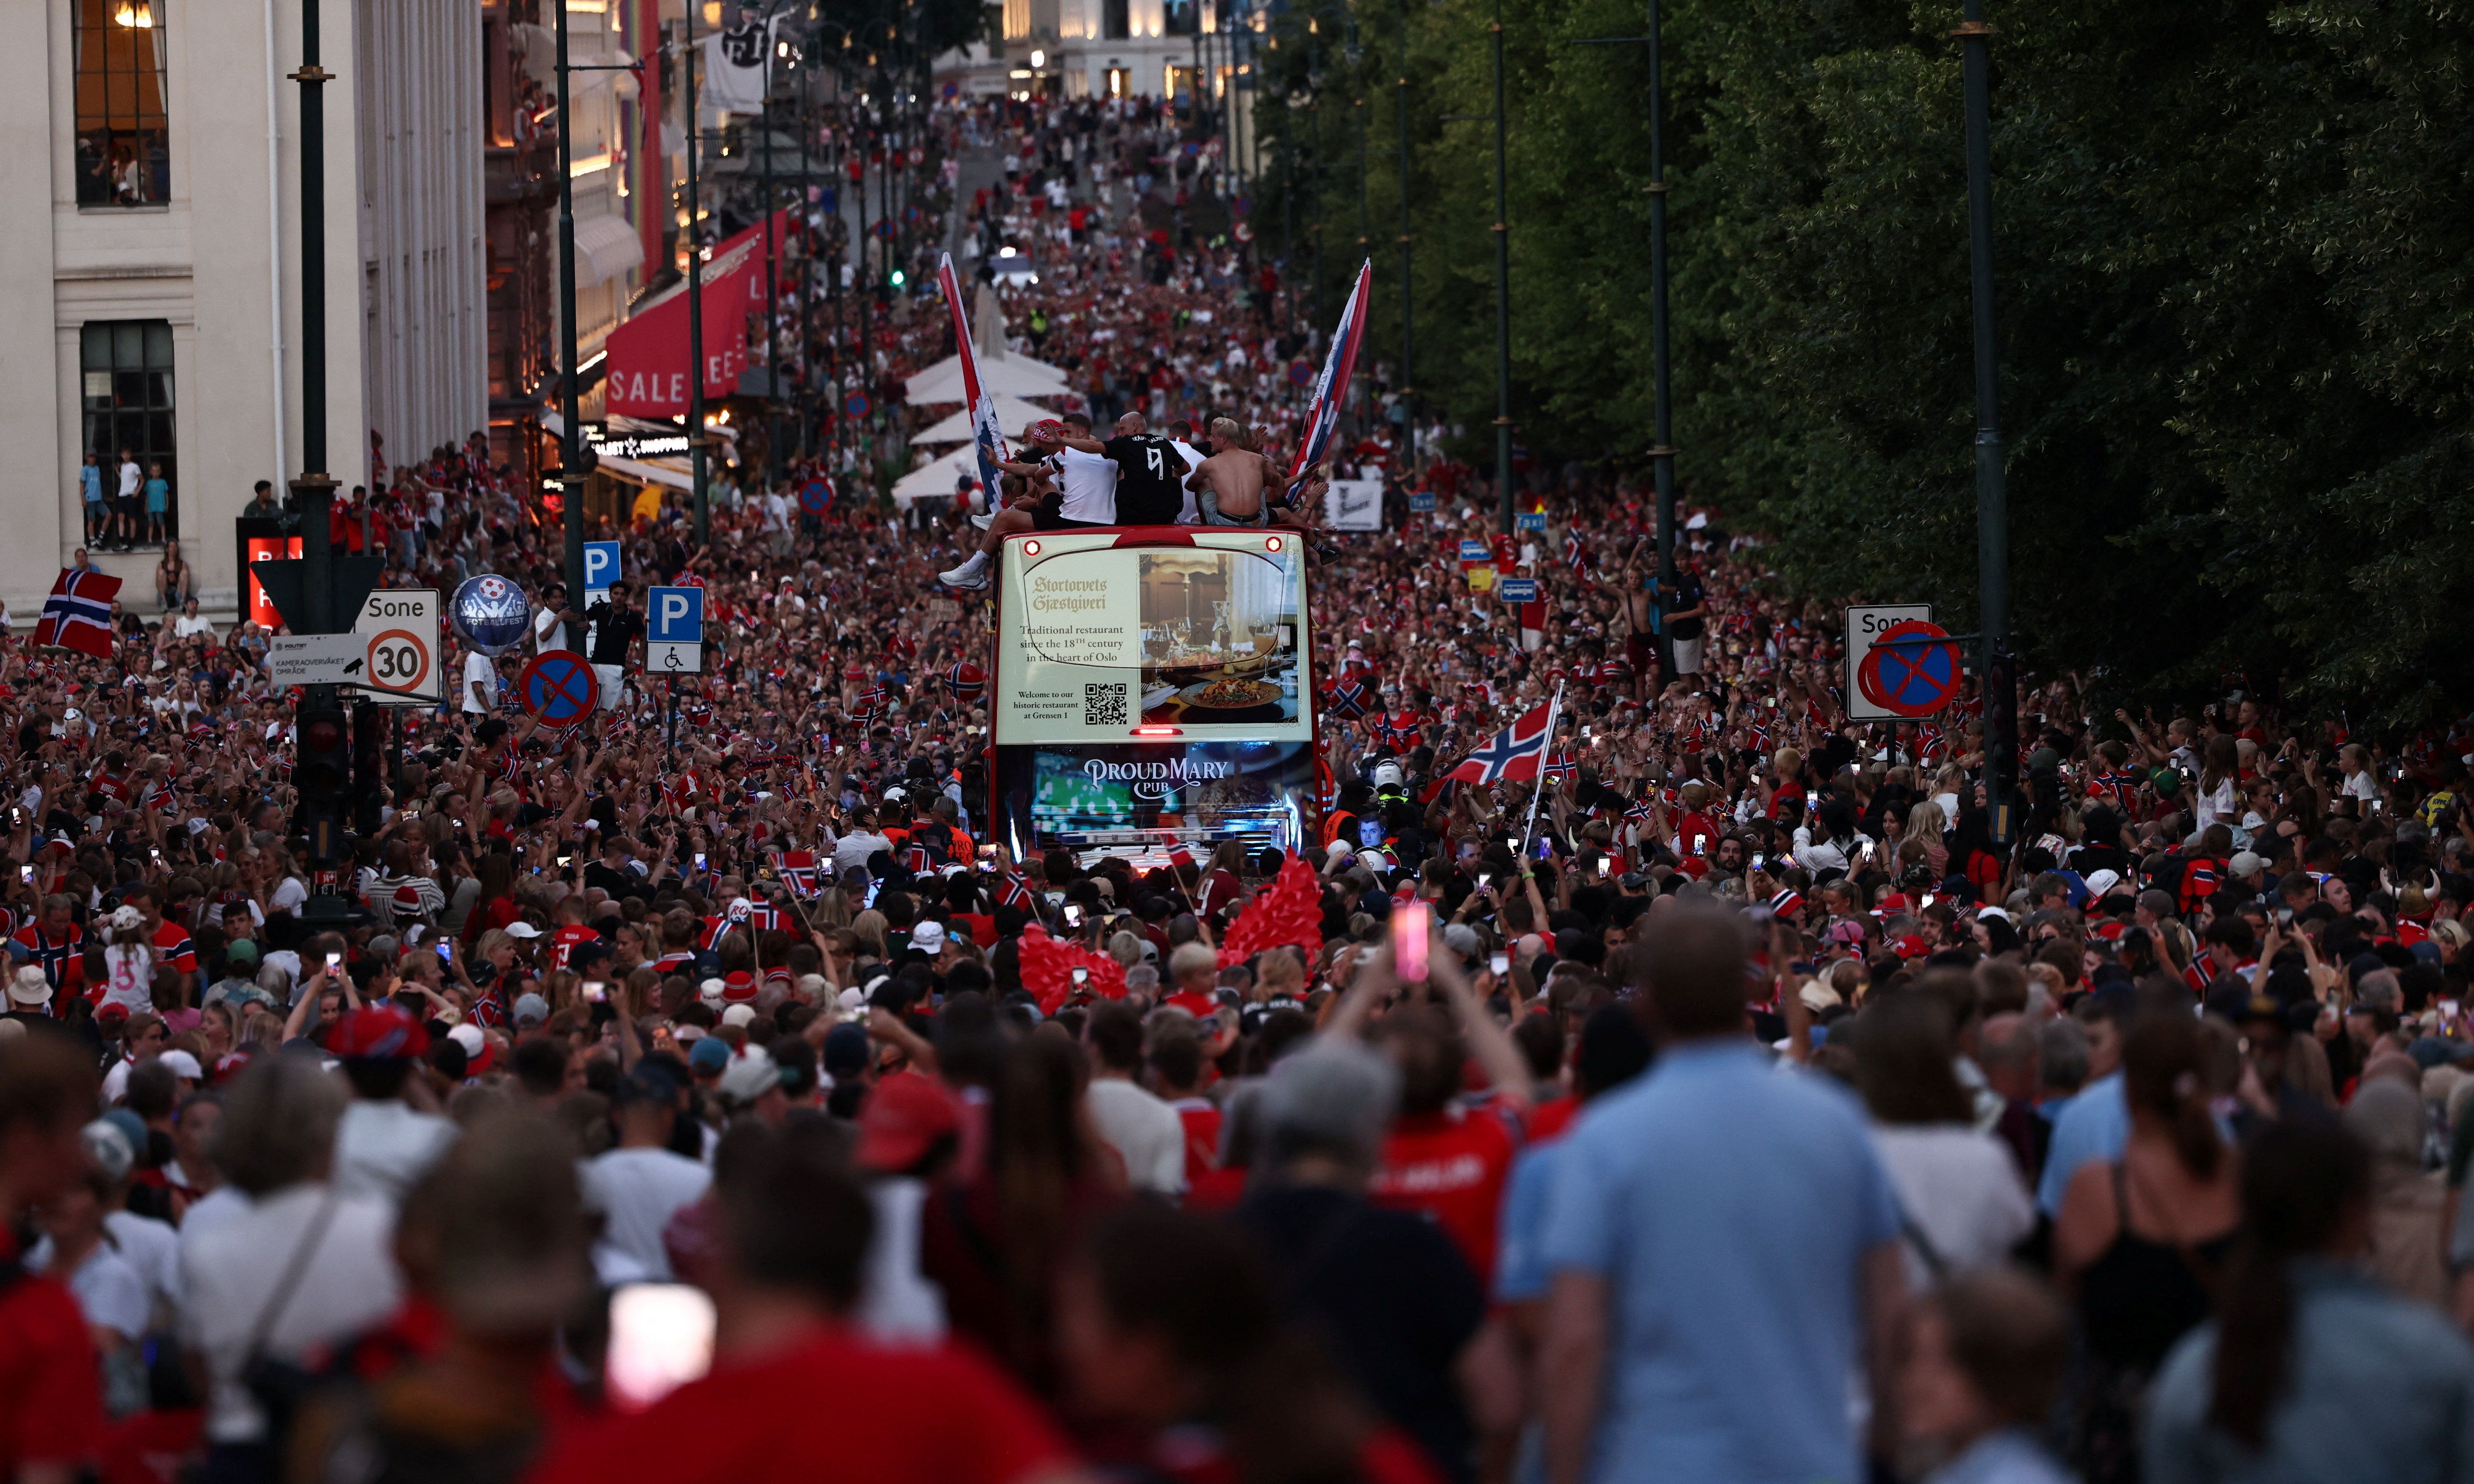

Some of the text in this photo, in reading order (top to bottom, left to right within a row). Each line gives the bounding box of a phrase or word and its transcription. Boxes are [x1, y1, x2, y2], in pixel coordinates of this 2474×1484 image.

[610, 371, 684, 402] SALE
[1146, 447, 1163, 480] 9
[586, 549, 608, 584] P
[1032, 575, 1107, 594] Stortorvets
[369, 598, 424, 617] Sone
[1033, 594, 1106, 613] Gjæstgiveri
[466, 617, 523, 626] FOTBALLFEST
[662, 594, 689, 634] P
[1020, 625, 1073, 634] Traditional
[1020, 640, 1043, 648] since
[1046, 639, 1061, 648] the
[1088, 641, 1123, 650] century
[276, 657, 345, 667] KAMERAOVERVÅKET
[377, 646, 418, 678] 30
[1027, 652, 1117, 662] in the heart of Oslo
[1084, 758, 1229, 788] PROUD MARY
[1143, 782, 1169, 793] PUB
[115, 960, 136, 991] 5
